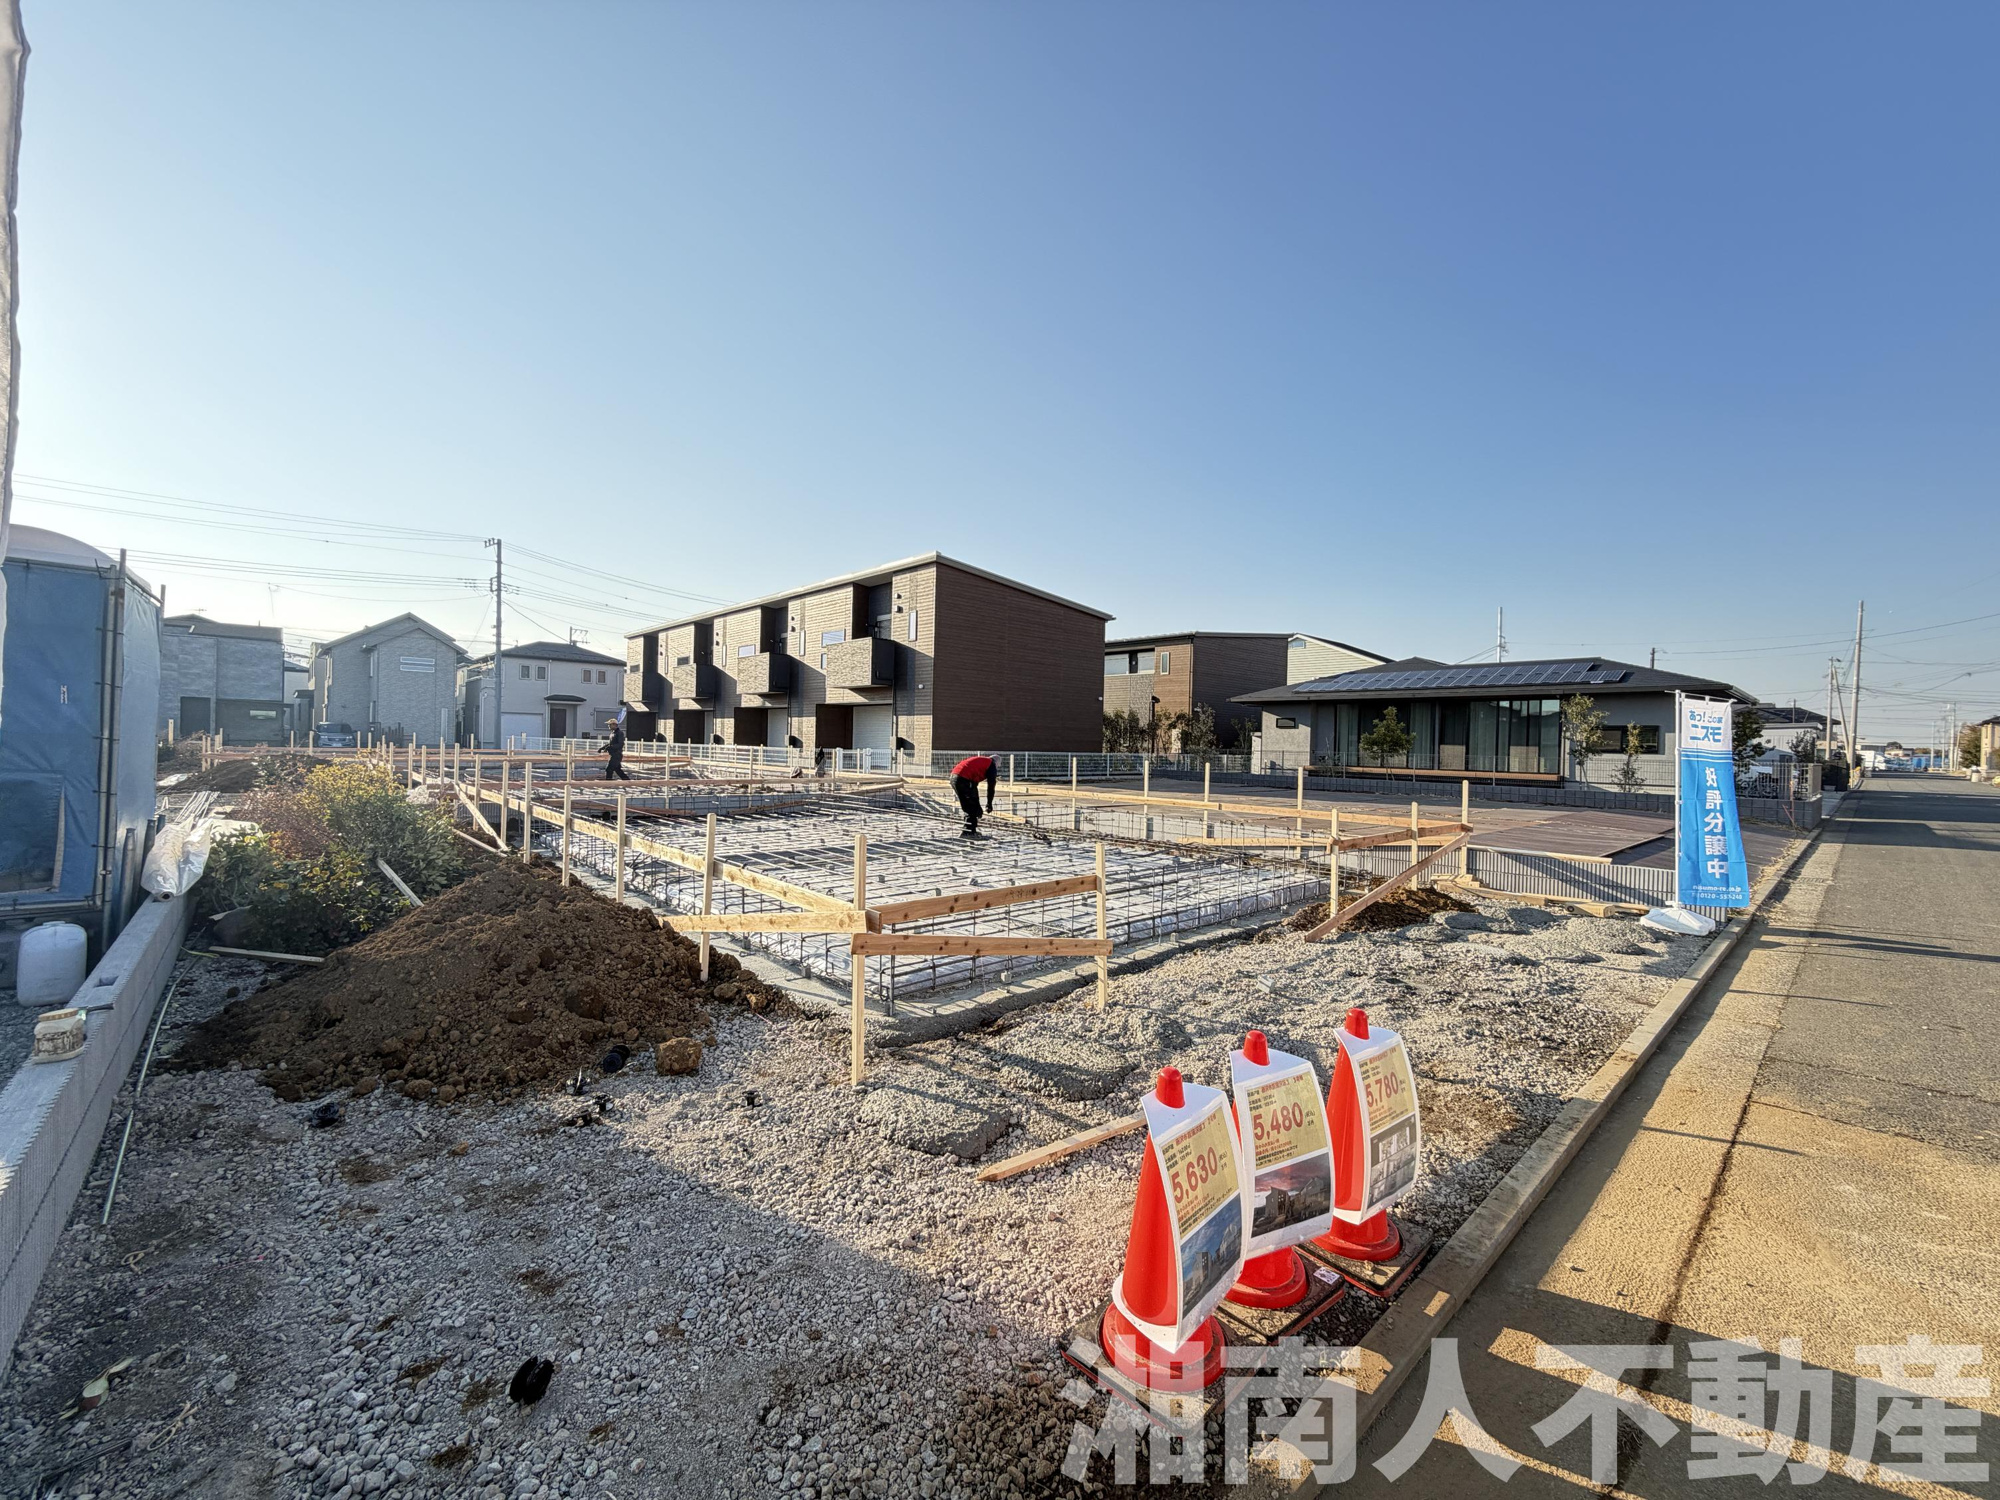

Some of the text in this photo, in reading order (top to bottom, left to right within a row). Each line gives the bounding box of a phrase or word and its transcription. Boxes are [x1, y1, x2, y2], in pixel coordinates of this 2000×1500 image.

[1690, 724, 1722, 743] ニスモ
[1704, 767, 1729, 879] 好評分譲中
[1365, 1071, 1399, 1107] 5,780
[1253, 1101, 1303, 1141] 5,480
[1171, 1146, 1218, 1204] 5,630
